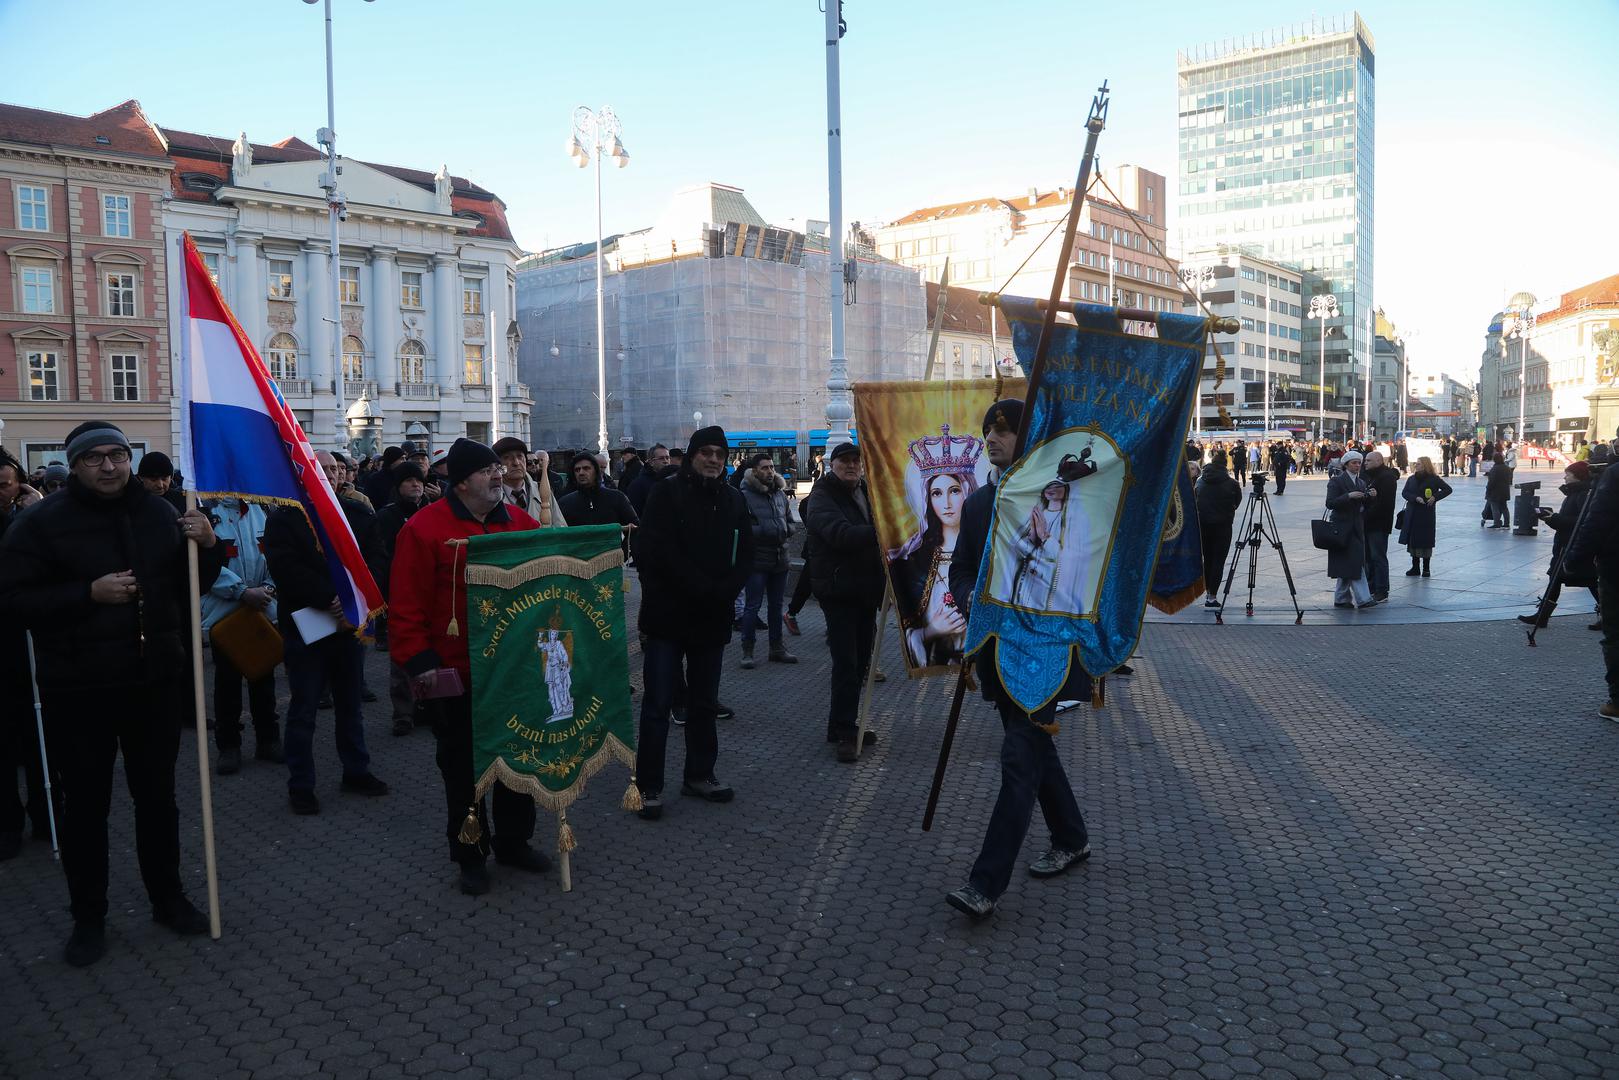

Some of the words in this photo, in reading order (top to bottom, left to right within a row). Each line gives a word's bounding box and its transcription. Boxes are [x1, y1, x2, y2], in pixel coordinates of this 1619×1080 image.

[483, 616, 510, 659] Sveti
[505, 584, 562, 619] Mihaele
[506, 714, 546, 743] brani
[548, 729, 569, 744] nas
[569, 724, 577, 737] u
[575, 695, 603, 730] boju!
